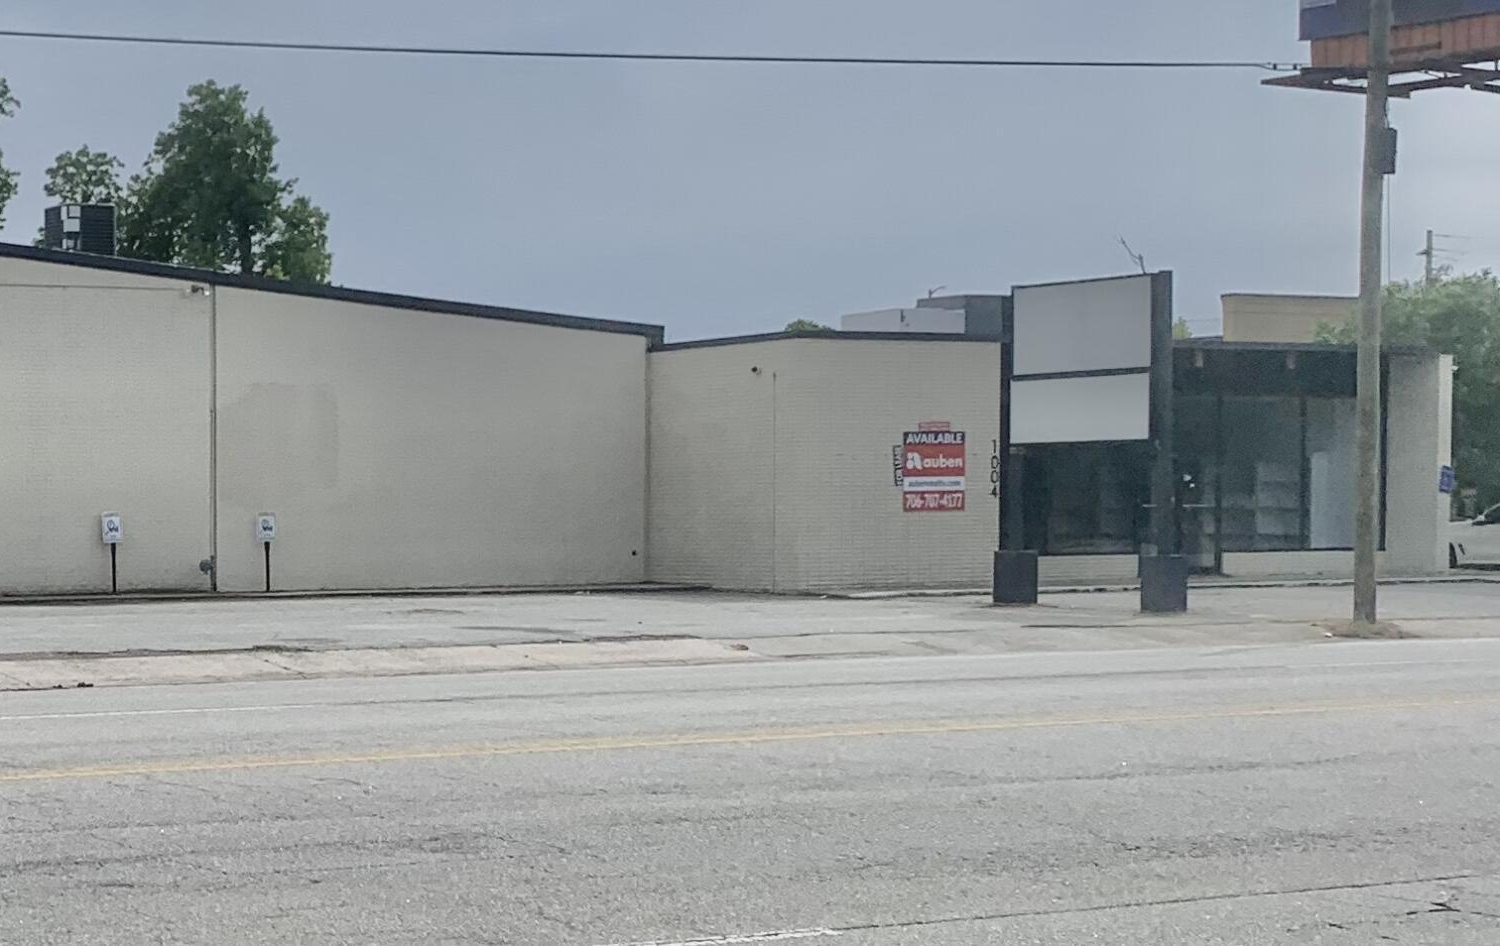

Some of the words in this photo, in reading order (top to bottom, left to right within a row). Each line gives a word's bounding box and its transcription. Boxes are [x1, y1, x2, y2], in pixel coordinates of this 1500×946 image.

[907, 433, 963, 444] AVAILABLE
[923, 454, 963, 468] auben
[990, 440, 999, 498] 1004
